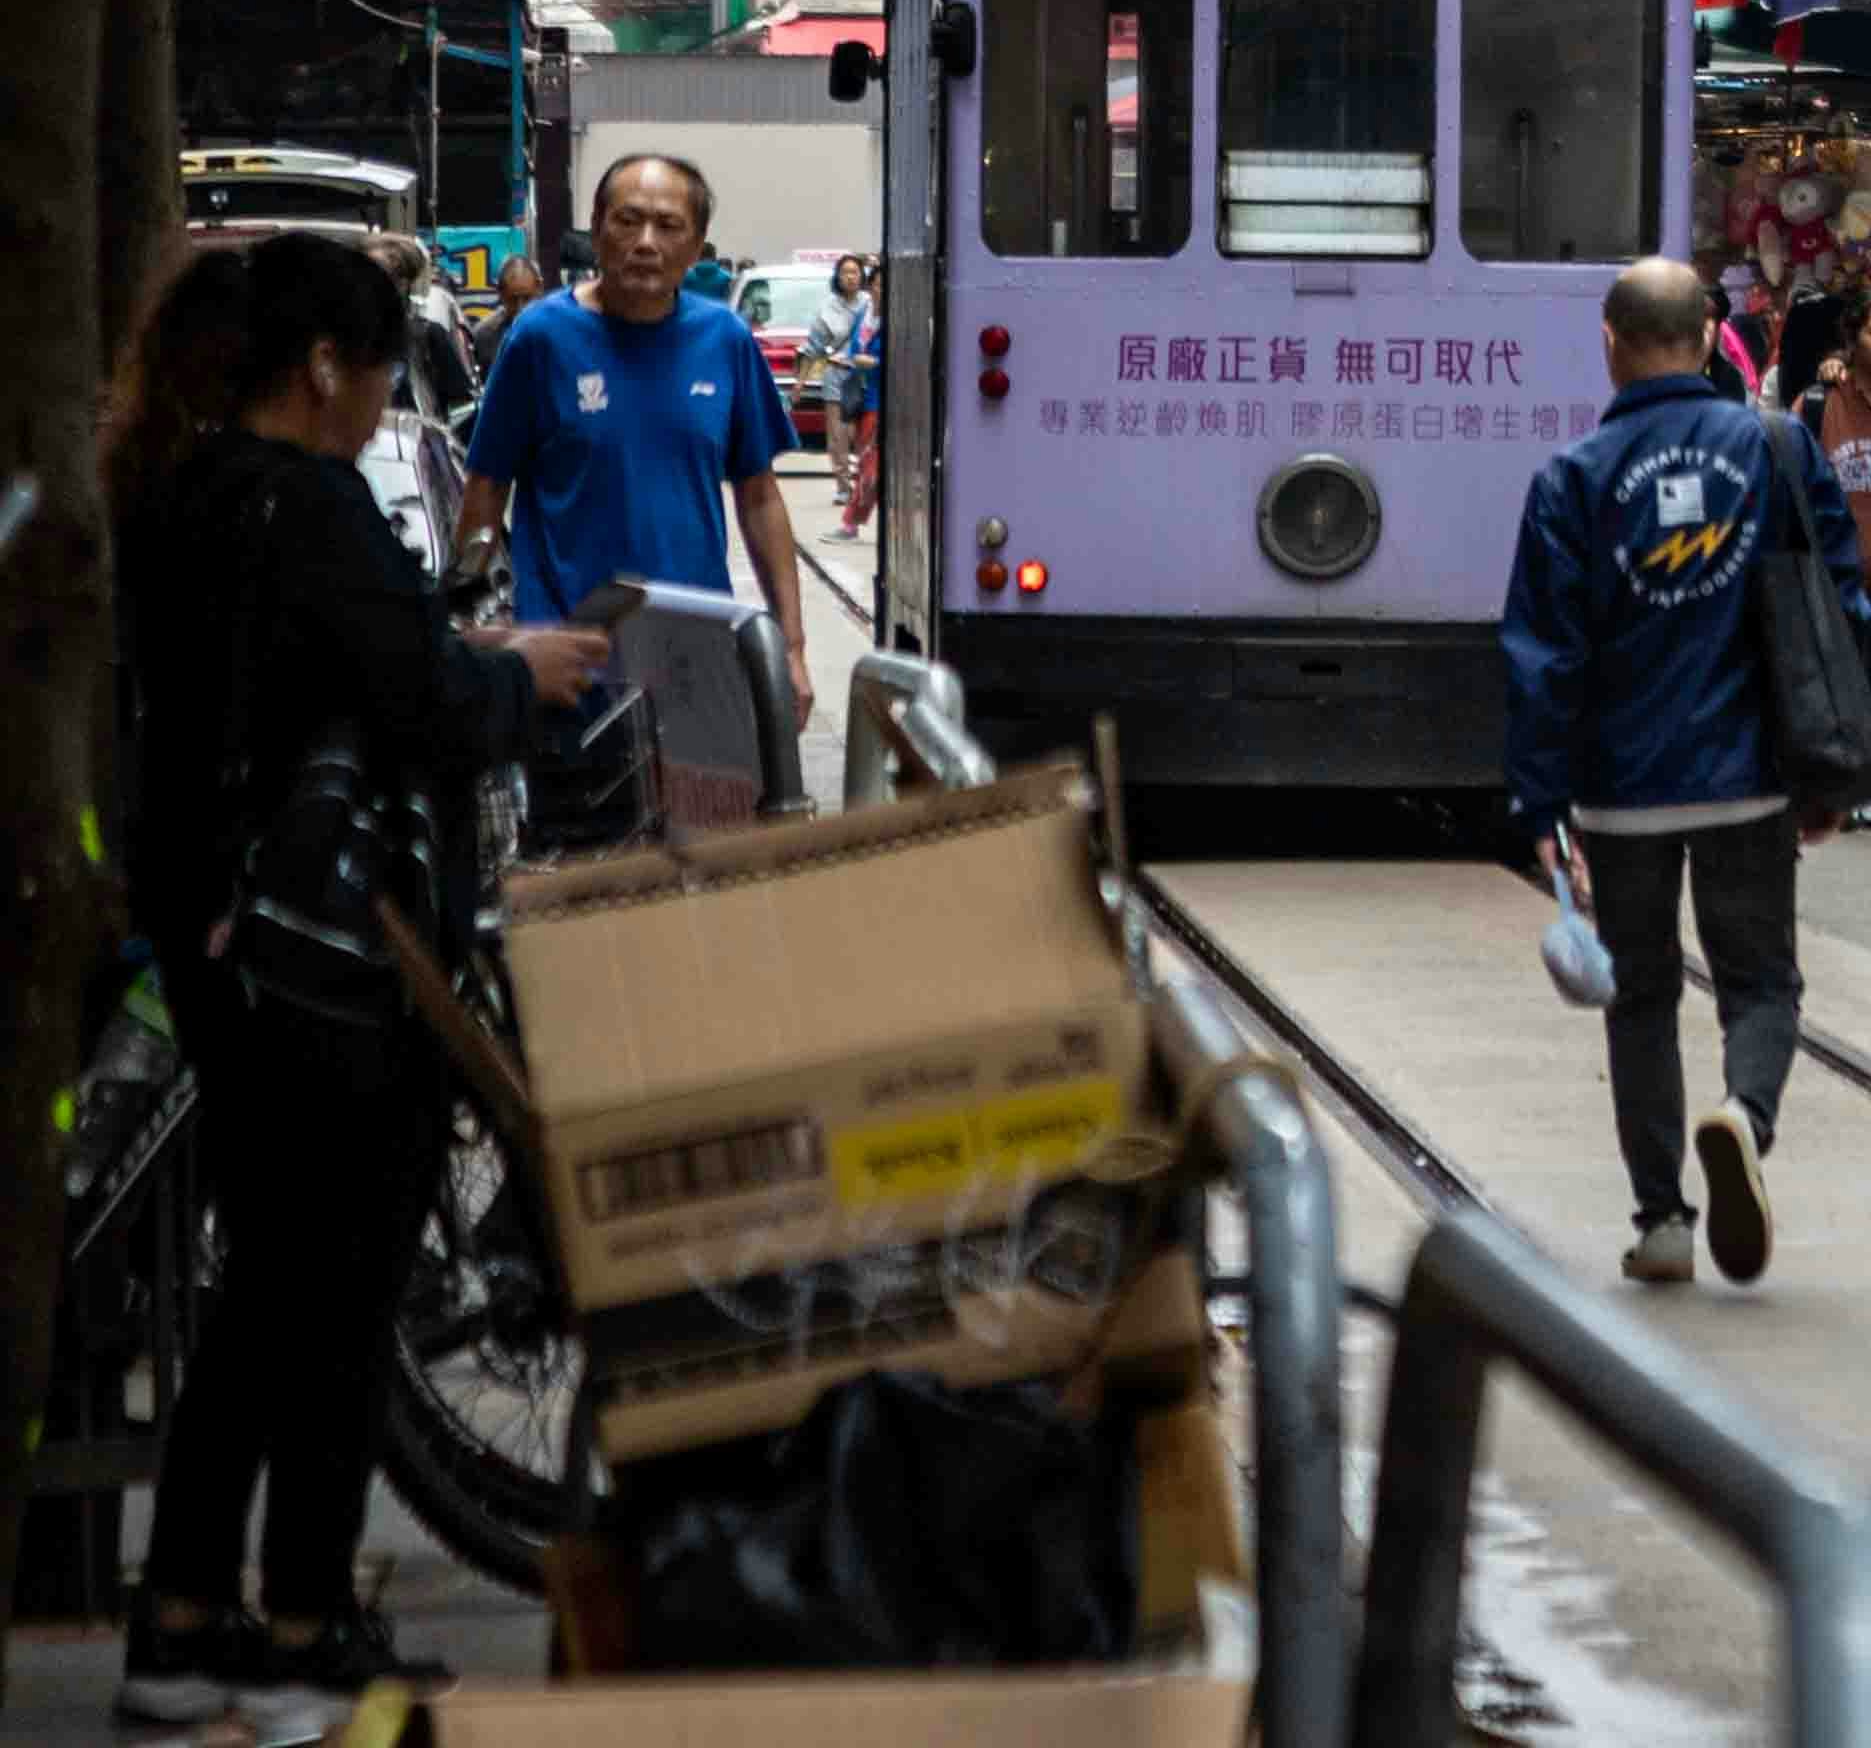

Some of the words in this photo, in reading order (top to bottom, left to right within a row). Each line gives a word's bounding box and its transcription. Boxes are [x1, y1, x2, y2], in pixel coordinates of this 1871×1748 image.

[1116, 335, 1309, 385] 原廠正貨
[1334, 337, 1525, 387] 無可取代
